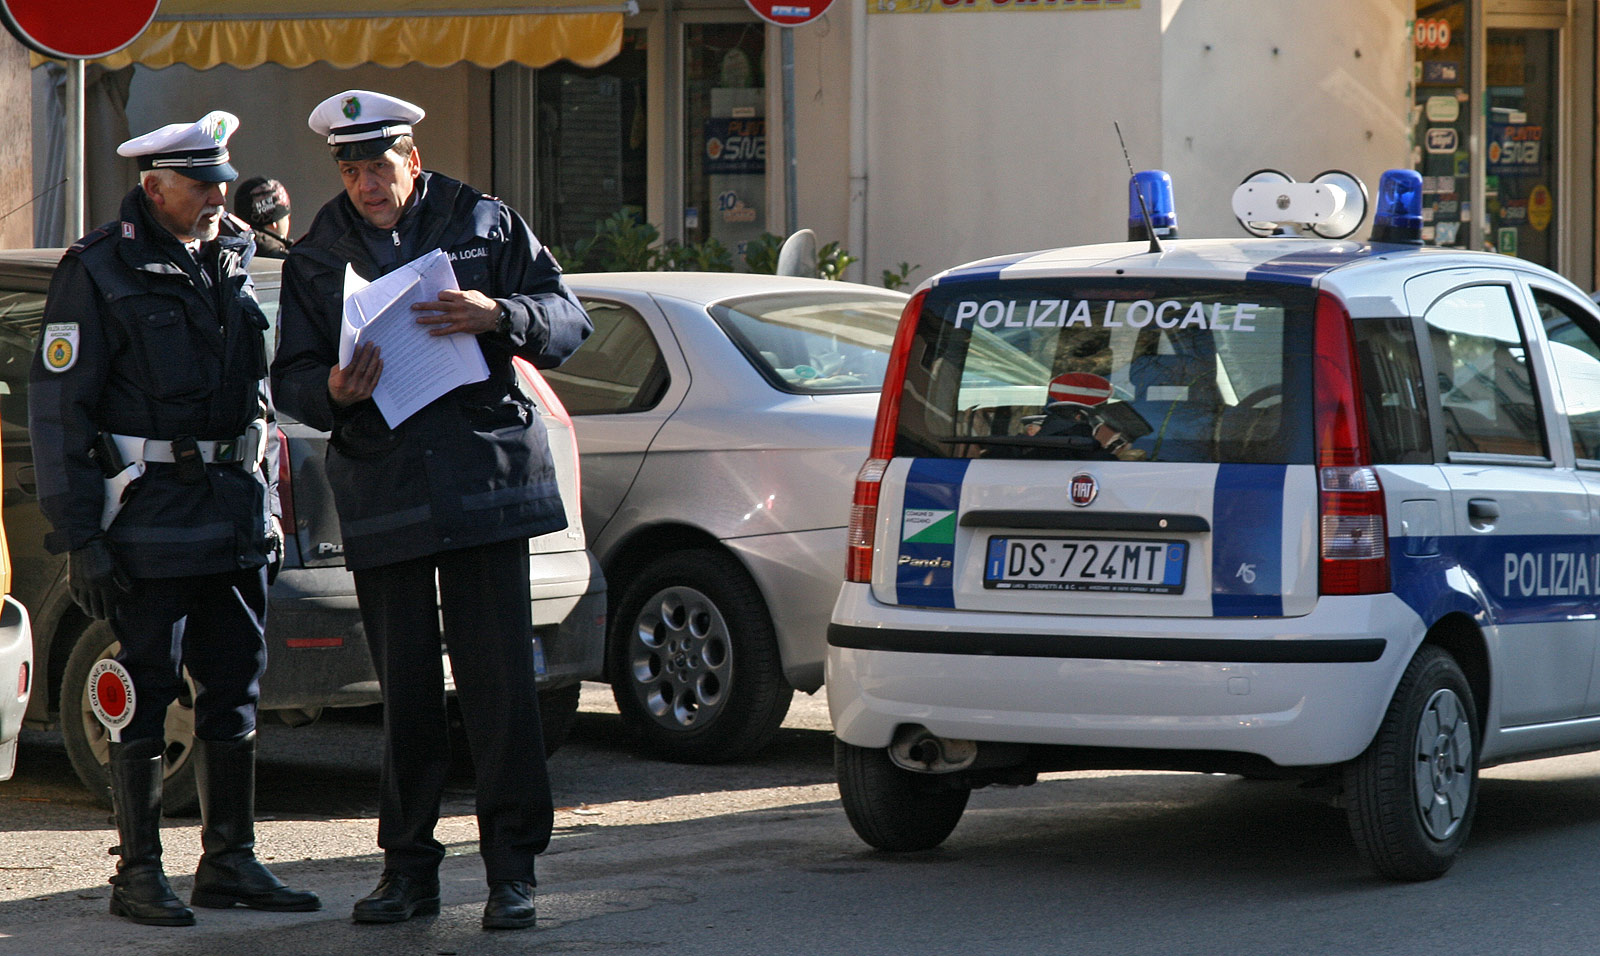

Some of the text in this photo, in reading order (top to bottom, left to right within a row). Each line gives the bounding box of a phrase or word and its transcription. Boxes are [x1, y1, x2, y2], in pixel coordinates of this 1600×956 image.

[954, 300, 1260, 332] POLIZIA LOCALE
[1073, 483, 1093, 498] FIAT
[898, 554, 952, 568] Panda
[1008, 543, 1162, 581] DS 724MT
[1504, 552, 1590, 597] POLIZIA
[90, 667, 101, 707] COMUNE
[109, 664, 132, 703] AVEZZANO
